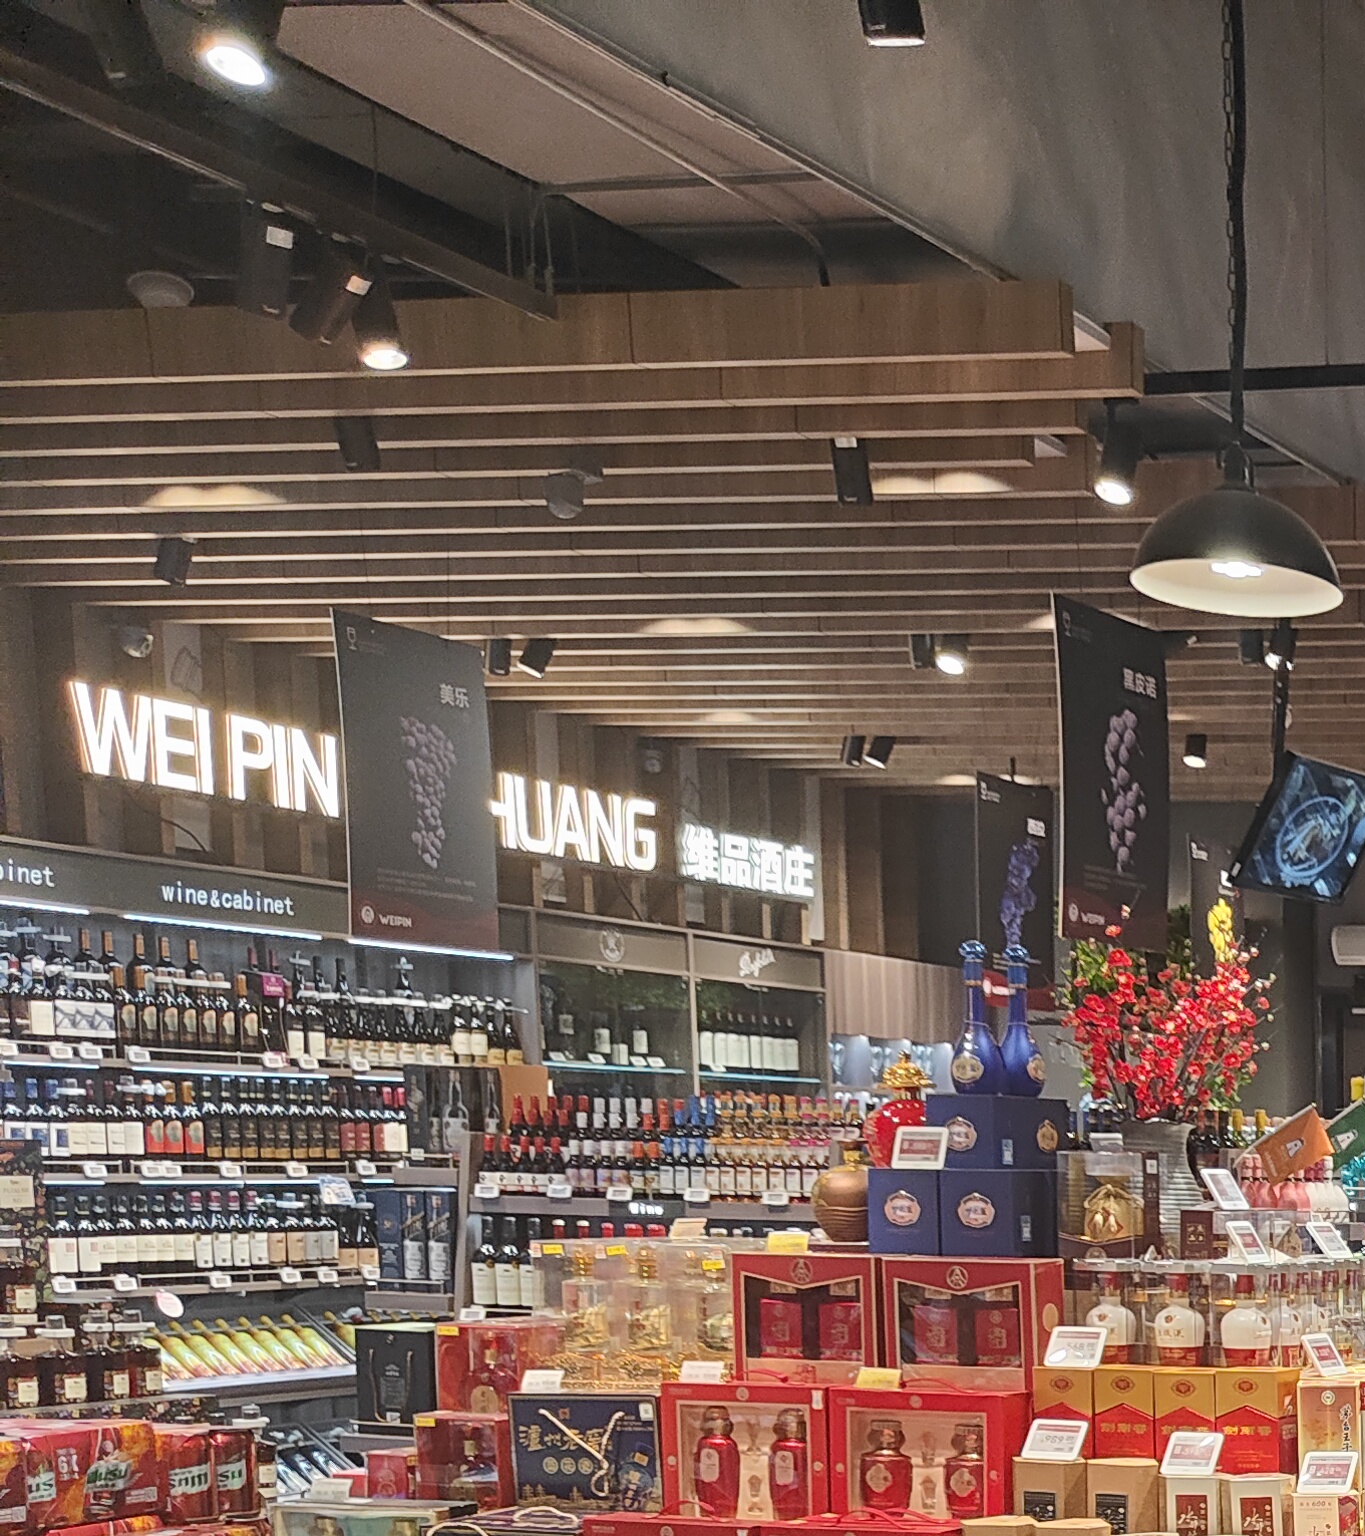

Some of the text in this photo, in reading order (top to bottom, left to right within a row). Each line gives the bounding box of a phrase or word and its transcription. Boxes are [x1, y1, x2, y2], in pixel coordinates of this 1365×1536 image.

[439, 683, 470, 708] 美乐
[1123, 667, 1157, 699] 黑皮诺
[67, 680, 214, 795] WEI
[228, 713, 340, 820] PIN
[679, 823, 816, 898] 维品酒庄
[161, 880, 295, 916] wine&cabinet
[378, 913, 413, 928] WEIPIN
